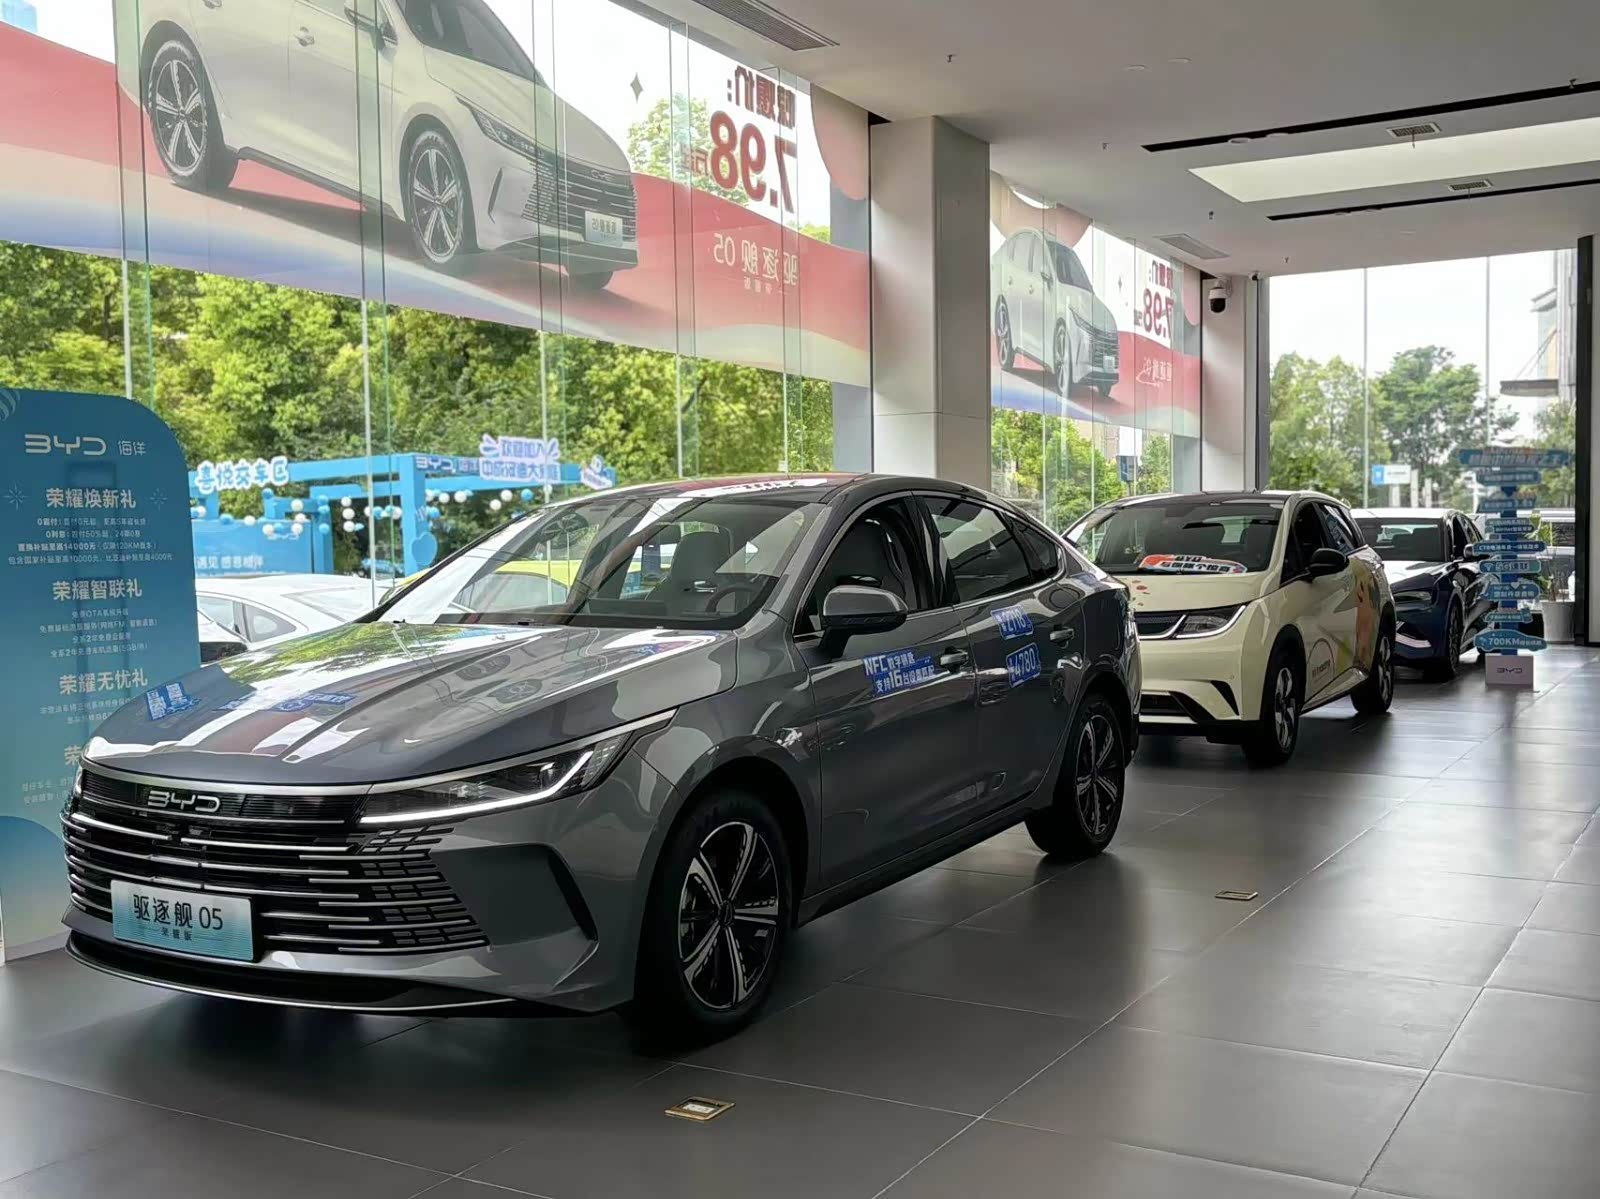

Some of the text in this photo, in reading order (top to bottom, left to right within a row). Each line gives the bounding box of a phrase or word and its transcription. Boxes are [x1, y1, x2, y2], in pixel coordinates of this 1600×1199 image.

[24, 433, 147, 456] BYD 海洋
[196, 457, 288, 493] 喜悦交车区
[416, 456, 454, 471] BYD
[46, 487, 136, 510] 荣耀焕新礼
[52, 579, 143, 601] 荣耀智联礼
[1014, 647, 1036, 677] 4780
[59, 667, 149, 696] 荣耀无忧礼
[148, 790, 220, 813] BYD
[133, 894, 224, 930] 驱逐舰 05
